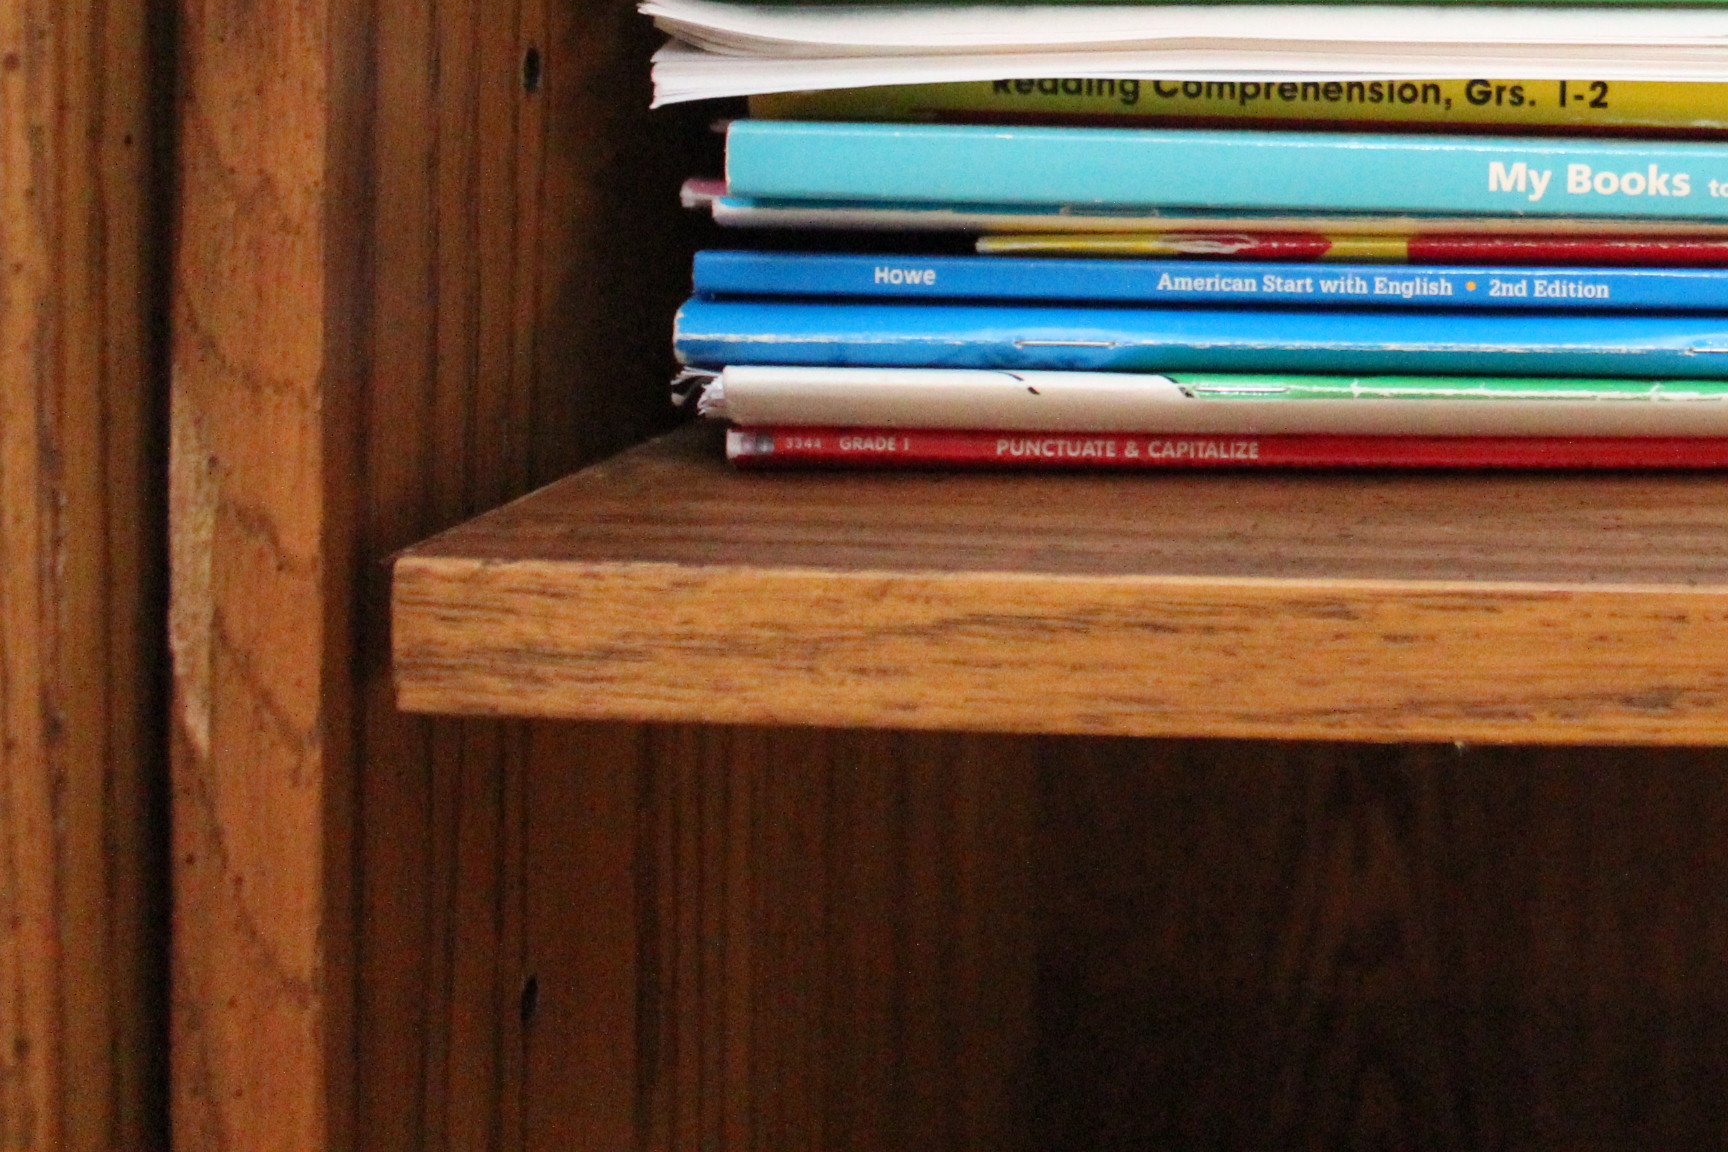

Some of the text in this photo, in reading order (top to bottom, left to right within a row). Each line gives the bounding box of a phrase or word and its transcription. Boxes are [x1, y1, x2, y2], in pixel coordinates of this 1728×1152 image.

[1465, 79, 1536, 107] Grs.
[1488, 162, 1551, 201] My
[1567, 163, 1691, 197] Books
[874, 265, 936, 286] Howe
[1156, 273, 1609, 299] American Start with English 2nd Edition
[839, 437, 896, 451] GRADE
[996, 439, 1259, 459] PUNCTUATE & CAPITALIZE
